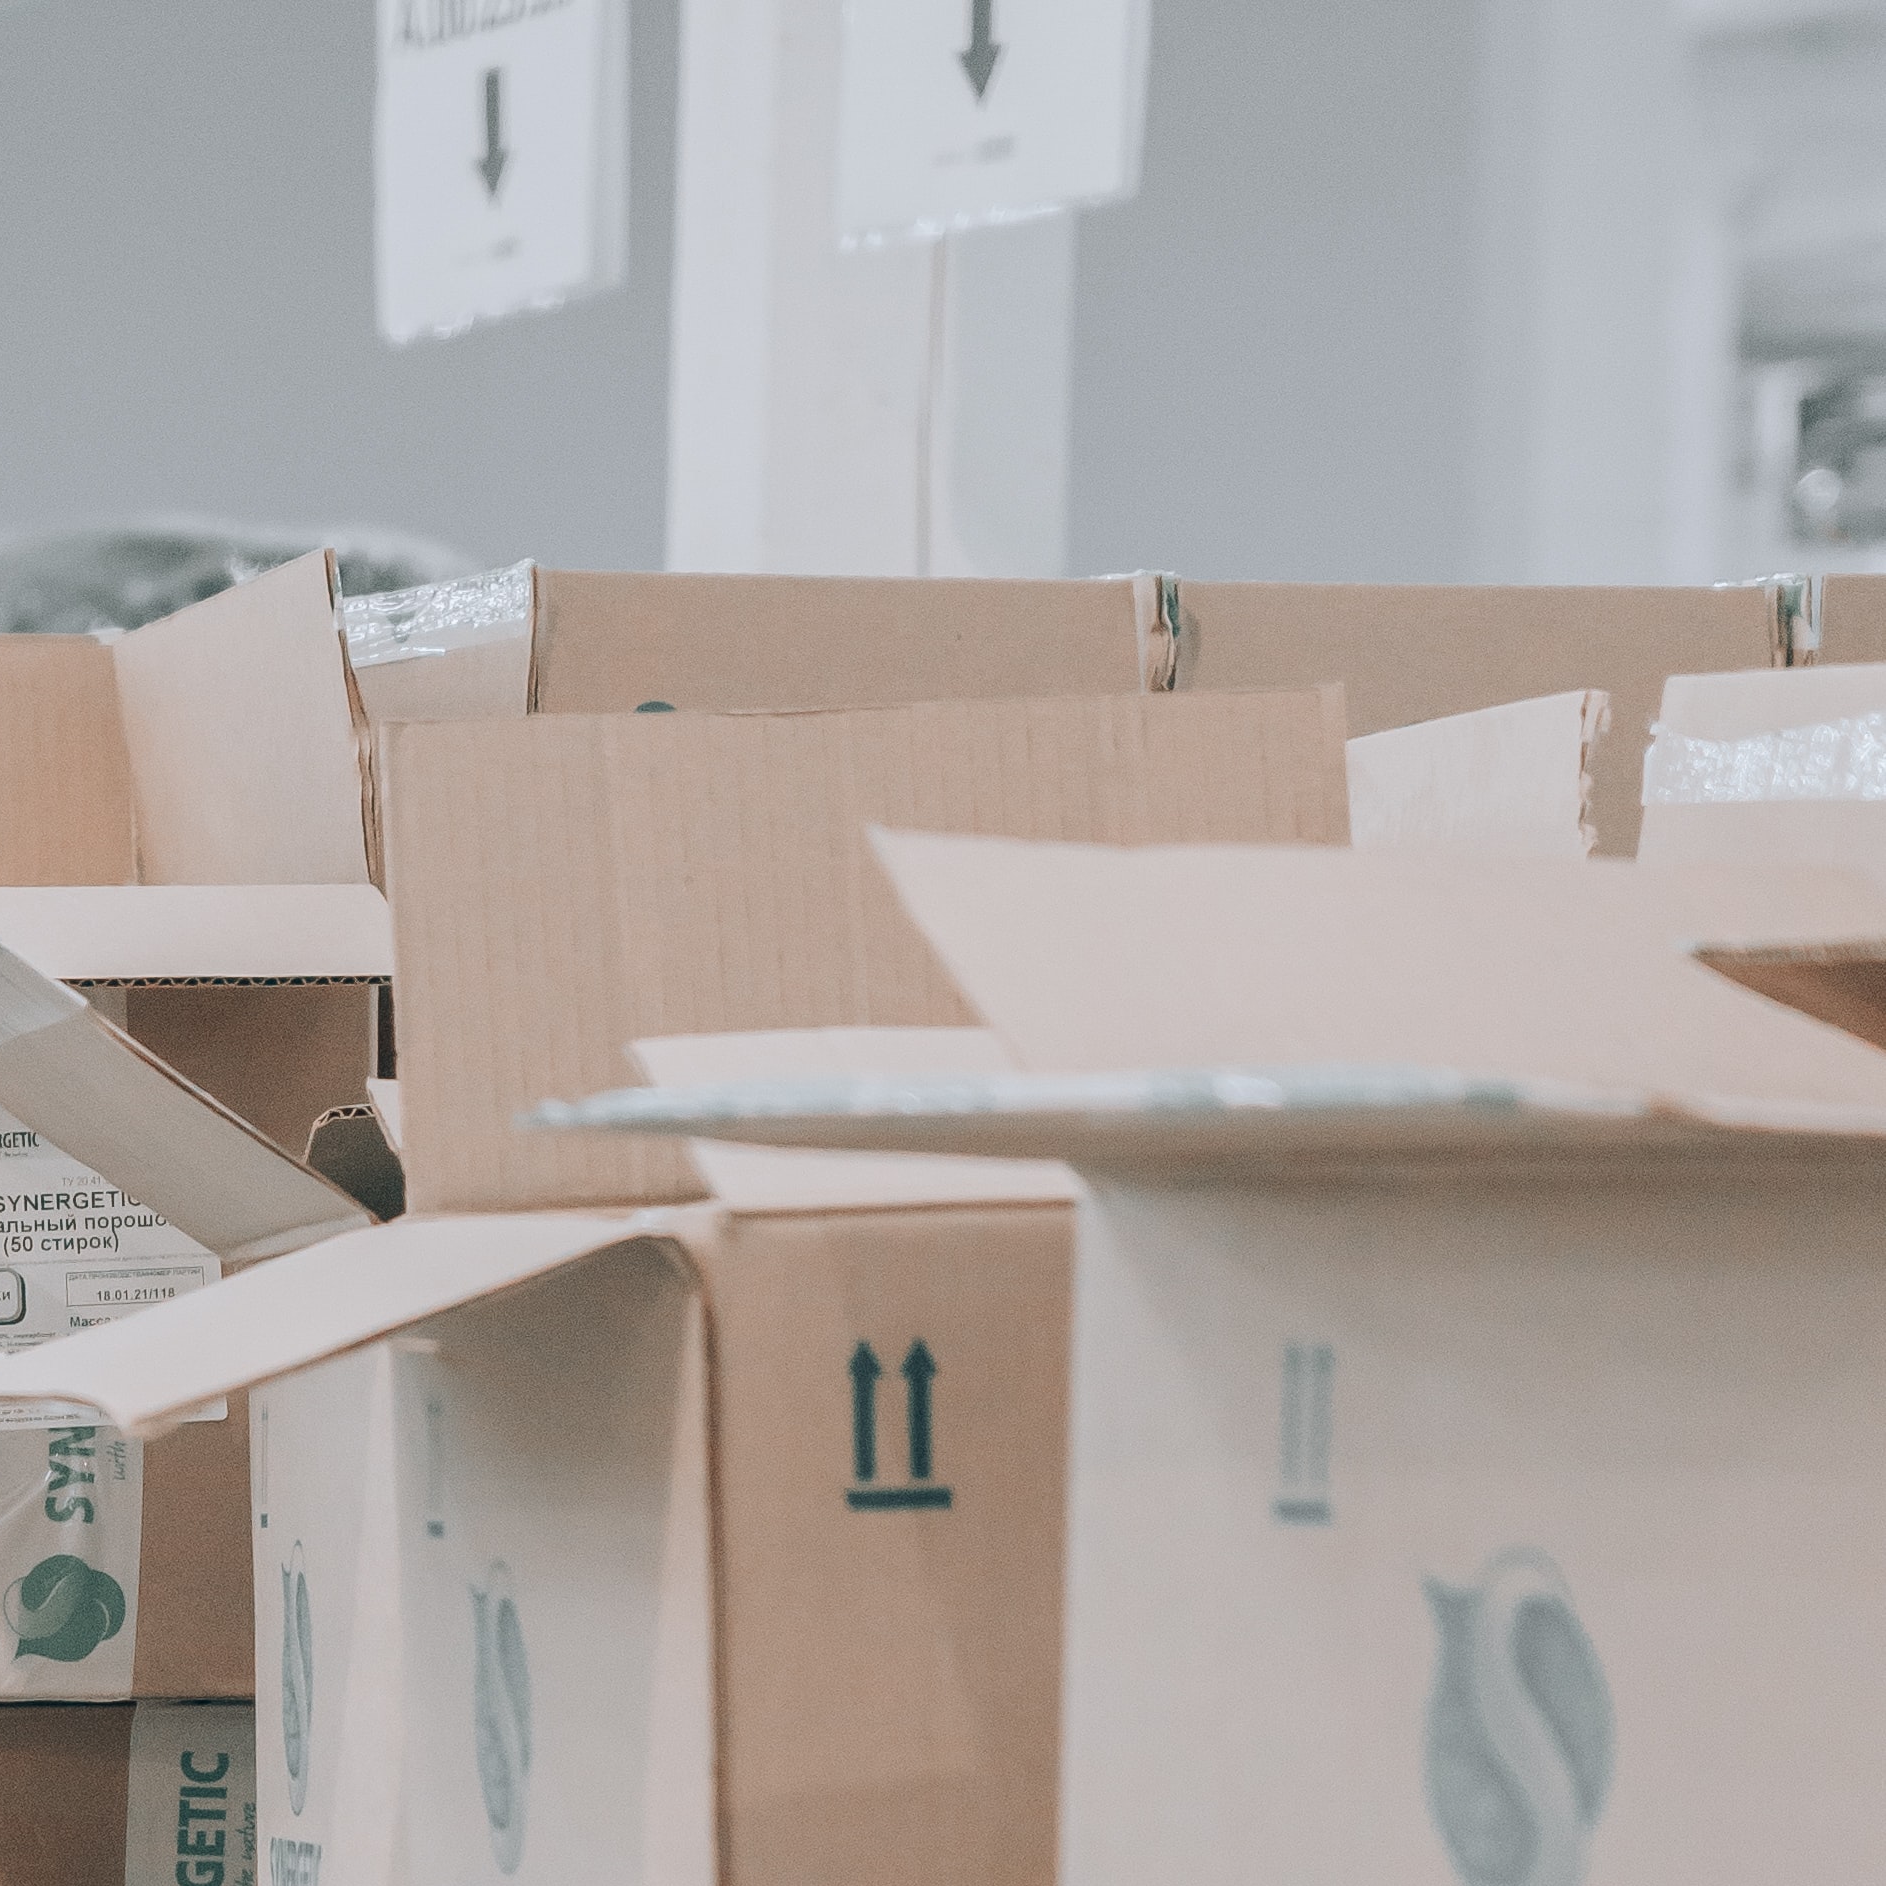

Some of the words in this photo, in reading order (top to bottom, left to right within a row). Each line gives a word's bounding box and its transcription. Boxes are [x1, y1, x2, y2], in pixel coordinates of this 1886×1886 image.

[84, 1212, 166, 1239] порошо
[3, 1236, 33, 1257] (50
[41, 1232, 119, 1254] стирок)
